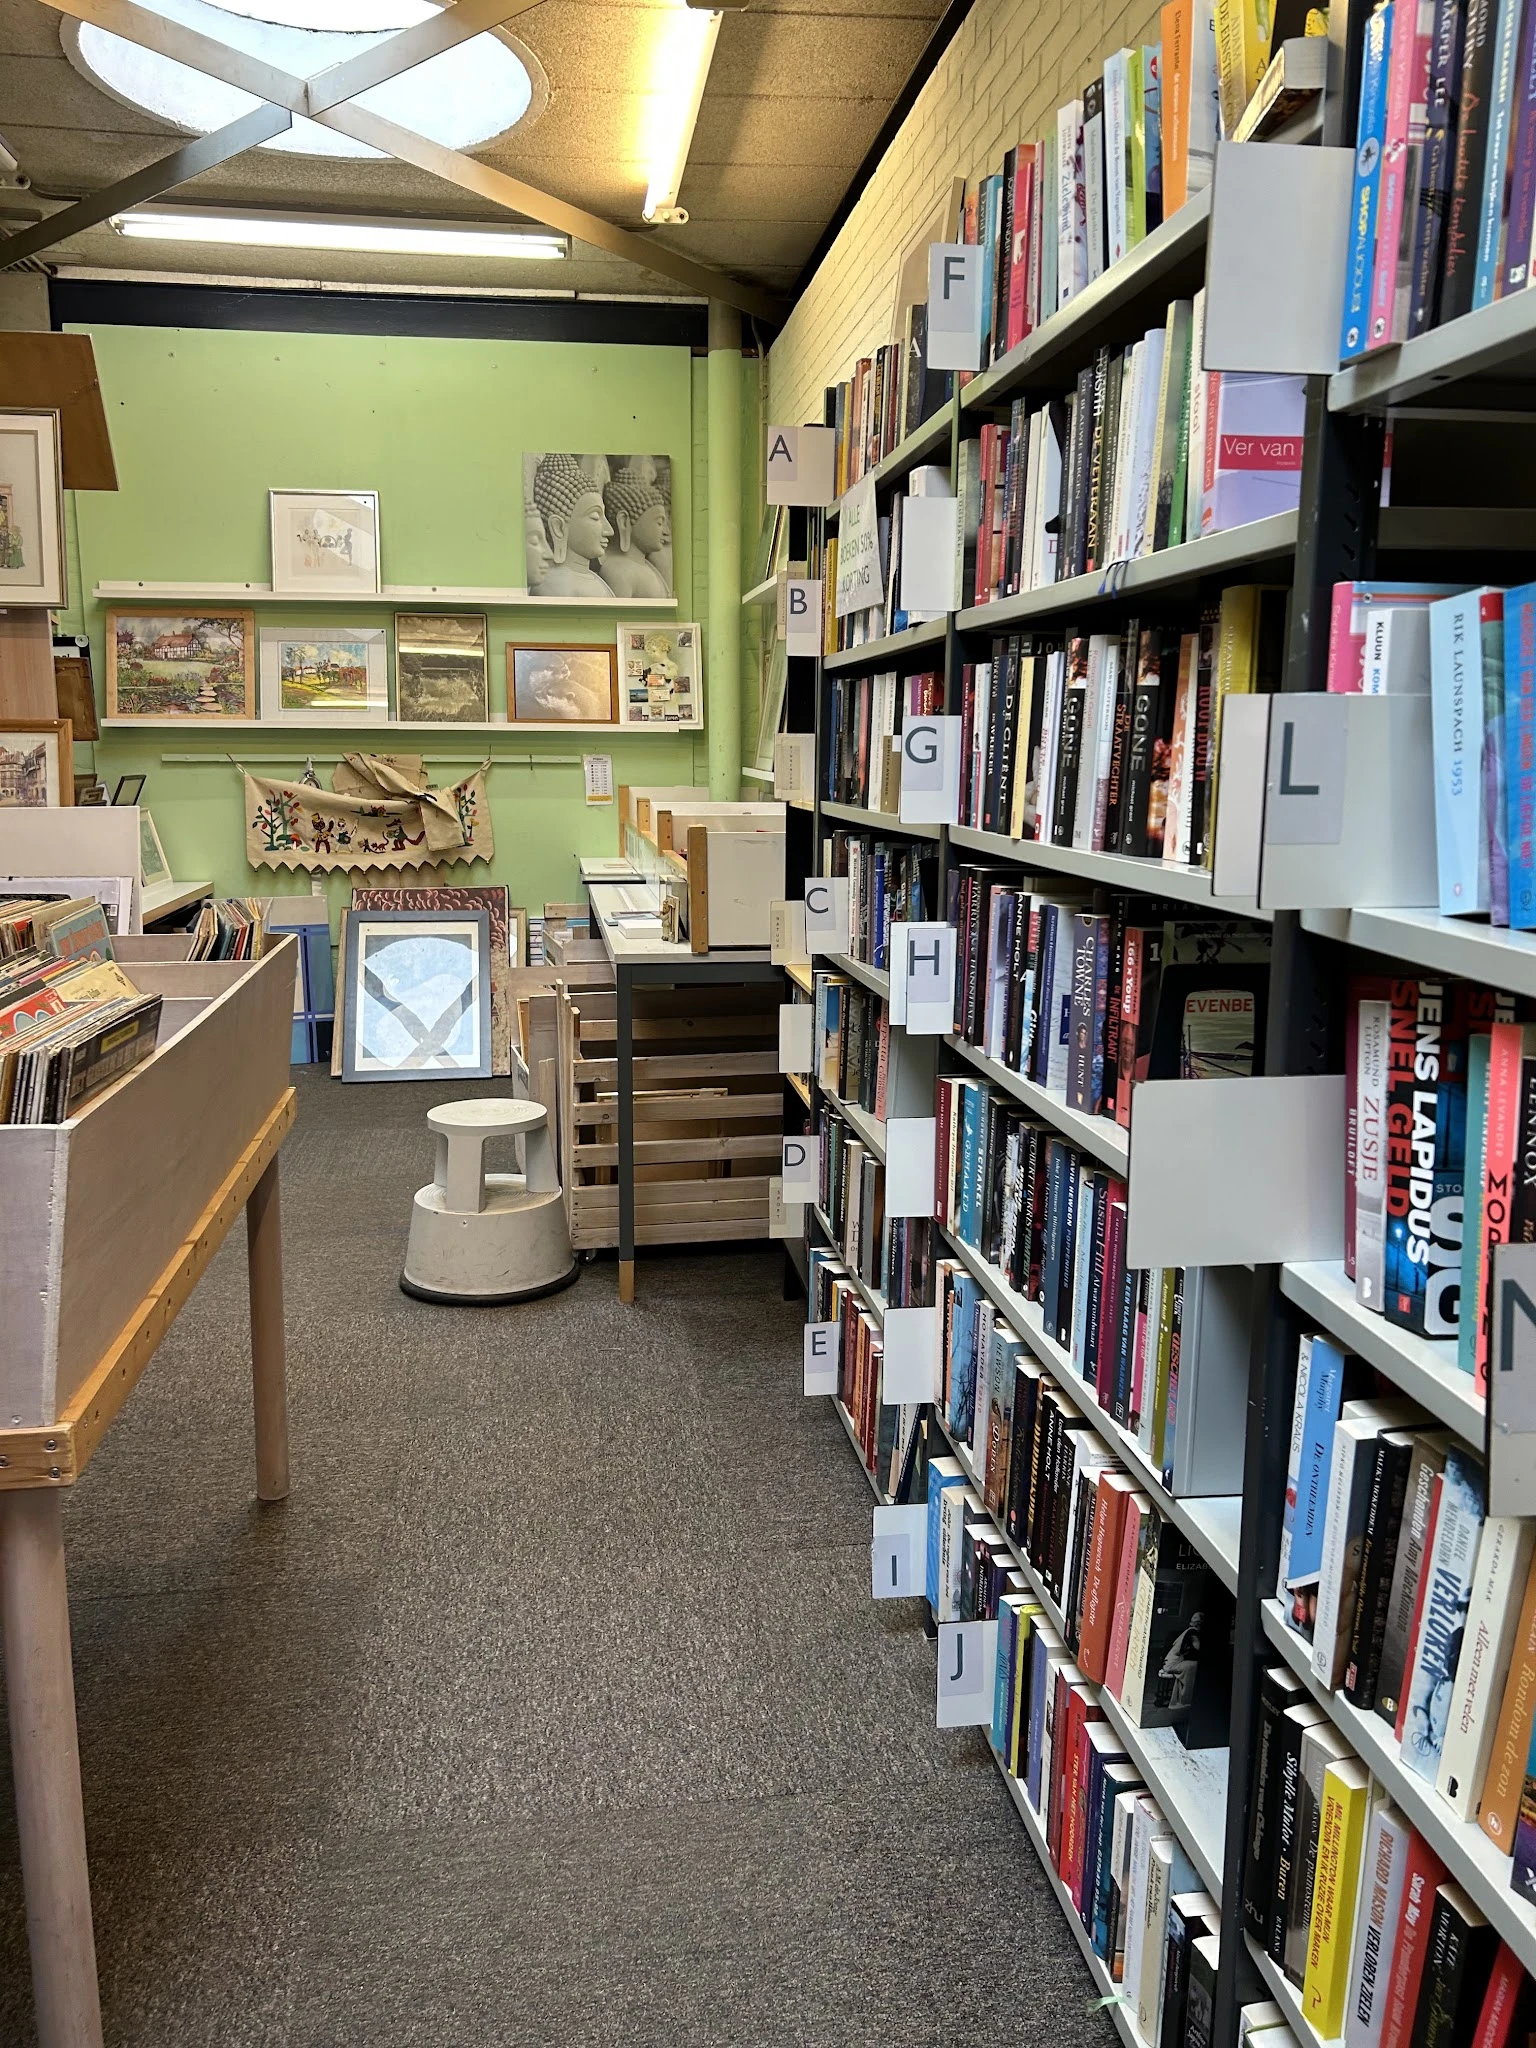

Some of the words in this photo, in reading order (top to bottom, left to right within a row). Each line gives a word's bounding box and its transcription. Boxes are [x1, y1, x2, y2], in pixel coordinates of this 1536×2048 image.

[1173, 35, 1181, 70] Ferrante
[1231, 17, 1243, 60] ADAM
[943, 256, 965, 299] F
[1079, 379, 1087, 396] DE
[1077, 399, 1086, 451] BLAUWE
[1193, 384, 1202, 433] staal
[768, 434, 793, 463] A
[1095, 425, 1103, 445] DE
[1223, 438, 1254, 457] Ver
[1260, 442, 1295, 457] van
[1075, 455, 1084, 499] BERGEN
[1205, 460, 1214, 487] bed
[1088, 449, 1101, 548] VETERAAN
[842, 566, 870, 593] KORTING
[790, 588, 807, 615] B
[1374, 621, 1384, 661] KLUUN
[1454, 613, 1464, 645] RIK
[1454, 651, 1464, 753] LAUNSPACH
[1062, 697, 1078, 768] GONE
[1124, 715, 1130, 732] DE
[1131, 694, 1150, 772] GONE
[905, 726, 937, 764] G
[988, 725, 996, 776] WREKER
[1000, 727, 1011, 804] CLIËNT
[1109, 704, 1126, 806] STRAATVECHTER
[1280, 722, 1320, 795] L
[1452, 760, 1462, 796] 1953
[806, 887, 829, 914] C
[1015, 894, 1024, 936] ANNE
[909, 940, 940, 976] H
[1127, 940, 1135, 966] 166
[1074, 947, 1086, 1007] TOWNE
[1082, 936, 1094, 1017] CHARLES
[1123, 977, 1134, 1013] Youp
[1107, 997, 1121, 1063] INFILTRANT
[1390, 979, 1418, 1092] SNEL
[1414, 981, 1443, 1083] JENS
[1077, 1054, 1085, 1087] HUNT
[1364, 1026, 1372, 1076] LUPTON
[1371, 1016, 1381, 1087] ROSAMUND
[1500, 1048, 1509, 1085] ANNA
[784, 1143, 806, 1167] D
[1361, 1096, 1379, 1181] ZUSJE
[975, 1147, 984, 1208] SCHAKEL
[1028, 1137, 1037, 1182] ROBERT
[1388, 1103, 1414, 1218] GELD
[1407, 1091, 1438, 1264] LAPIDUS
[1025, 1185, 1034, 1228] HARRIS
[1066, 1186, 1074, 1227] HEWSON
[1095, 1188, 1108, 1237] Susan
[1063, 1229, 1072, 1288] POPPENHUIS
[1094, 1240, 1105, 1275] Hill
[1125, 1272, 1132, 1284] IN
[981, 1312, 987, 1329] MO
[1089, 1304, 1098, 1348] rondwaart
[1121, 1306, 1130, 1335] VLAAG
[811, 1330, 827, 1356] E
[979, 1335, 987, 1379] HAYDER
[1301, 1352, 1309, 1362] &
[994, 1342, 1003, 1393] HEWSON
[1118, 1356, 1127, 1399] WAANZIN
[1296, 1364, 1308, 1410] NICOLA
[1316, 1371, 1330, 1413] Murphy
[1047, 1409, 1055, 1444] ANNE
[1292, 1413, 1306, 1453] KRAUS
[1313, 1442, 1325, 1462] DE
[1374, 1448, 1385, 1483] MALIKA
[1053, 1455, 1061, 1494] Hollander
[1088, 1497, 1096, 1538] MAARTEN
[1100, 1498, 1108, 1526] Helga
[1305, 1464, 1320, 1538] ONTHEEMDEN
[1410, 1462, 1434, 1540] Geschonden
[1095, 1526, 1105, 1572] Hegewisch
[1404, 1538, 1423, 1567] Amy
[1438, 1500, 1459, 1567] MENDELSOHN
[1454, 1524, 1470, 1561] DANIEL
[1489, 1524, 1505, 1576] GERARDA
[1485, 1578, 1496, 1604] MAK
[1420, 1567, 1462, 1682] VERLOREN
[1472, 1620, 1491, 1670] Alleen
[950, 1633, 962, 1681] J
[1138, 1644, 1146, 1679] HOWARD
[1465, 1671, 1479, 1699] met
[1508, 1662, 1535, 1739] Rondom
[1461, 1698, 1477, 1734] velen
[1071, 1752, 1080, 1775] STER
[1504, 1740, 1520, 1763] de
[1069, 1777, 1078, 1798] VAN
[1282, 1752, 1298, 1801] Sibylle
[1497, 1763, 1515, 1798] zon
[1068, 1799, 1077, 1818] HET
[1280, 1800, 1294, 1845] Mulot
[1322, 1796, 1335, 1844] VRIENDIN
[1333, 1801, 1343, 1821] MIL
[1067, 1818, 1076, 1862] NOORDEN
[1321, 1846, 1330, 1861] EN
[1327, 1823, 1341, 1884] MILLINGTON
[1376, 1828, 1394, 1884] RICHARD
[1277, 1855, 1291, 1900] Buren
[1321, 1861, 1329, 1871] IK
[1317, 1872, 1328, 1902] RUZIE
[1324, 1886, 1335, 1920] WAAR
[1370, 1881, 1388, 1929] MASON
[1409, 1873, 1424, 1904] Sarah
[1273, 1916, 1282, 1954] BALANS
[1314, 1903, 1324, 1929] OVER
[1322, 1919, 1332, 1944] MIJN
[1310, 1928, 1322, 1969] MAKEN
[1361, 1925, 1381, 1989] VERLOREN
[1357, 1981, 1374, 2028] ZIELEN
